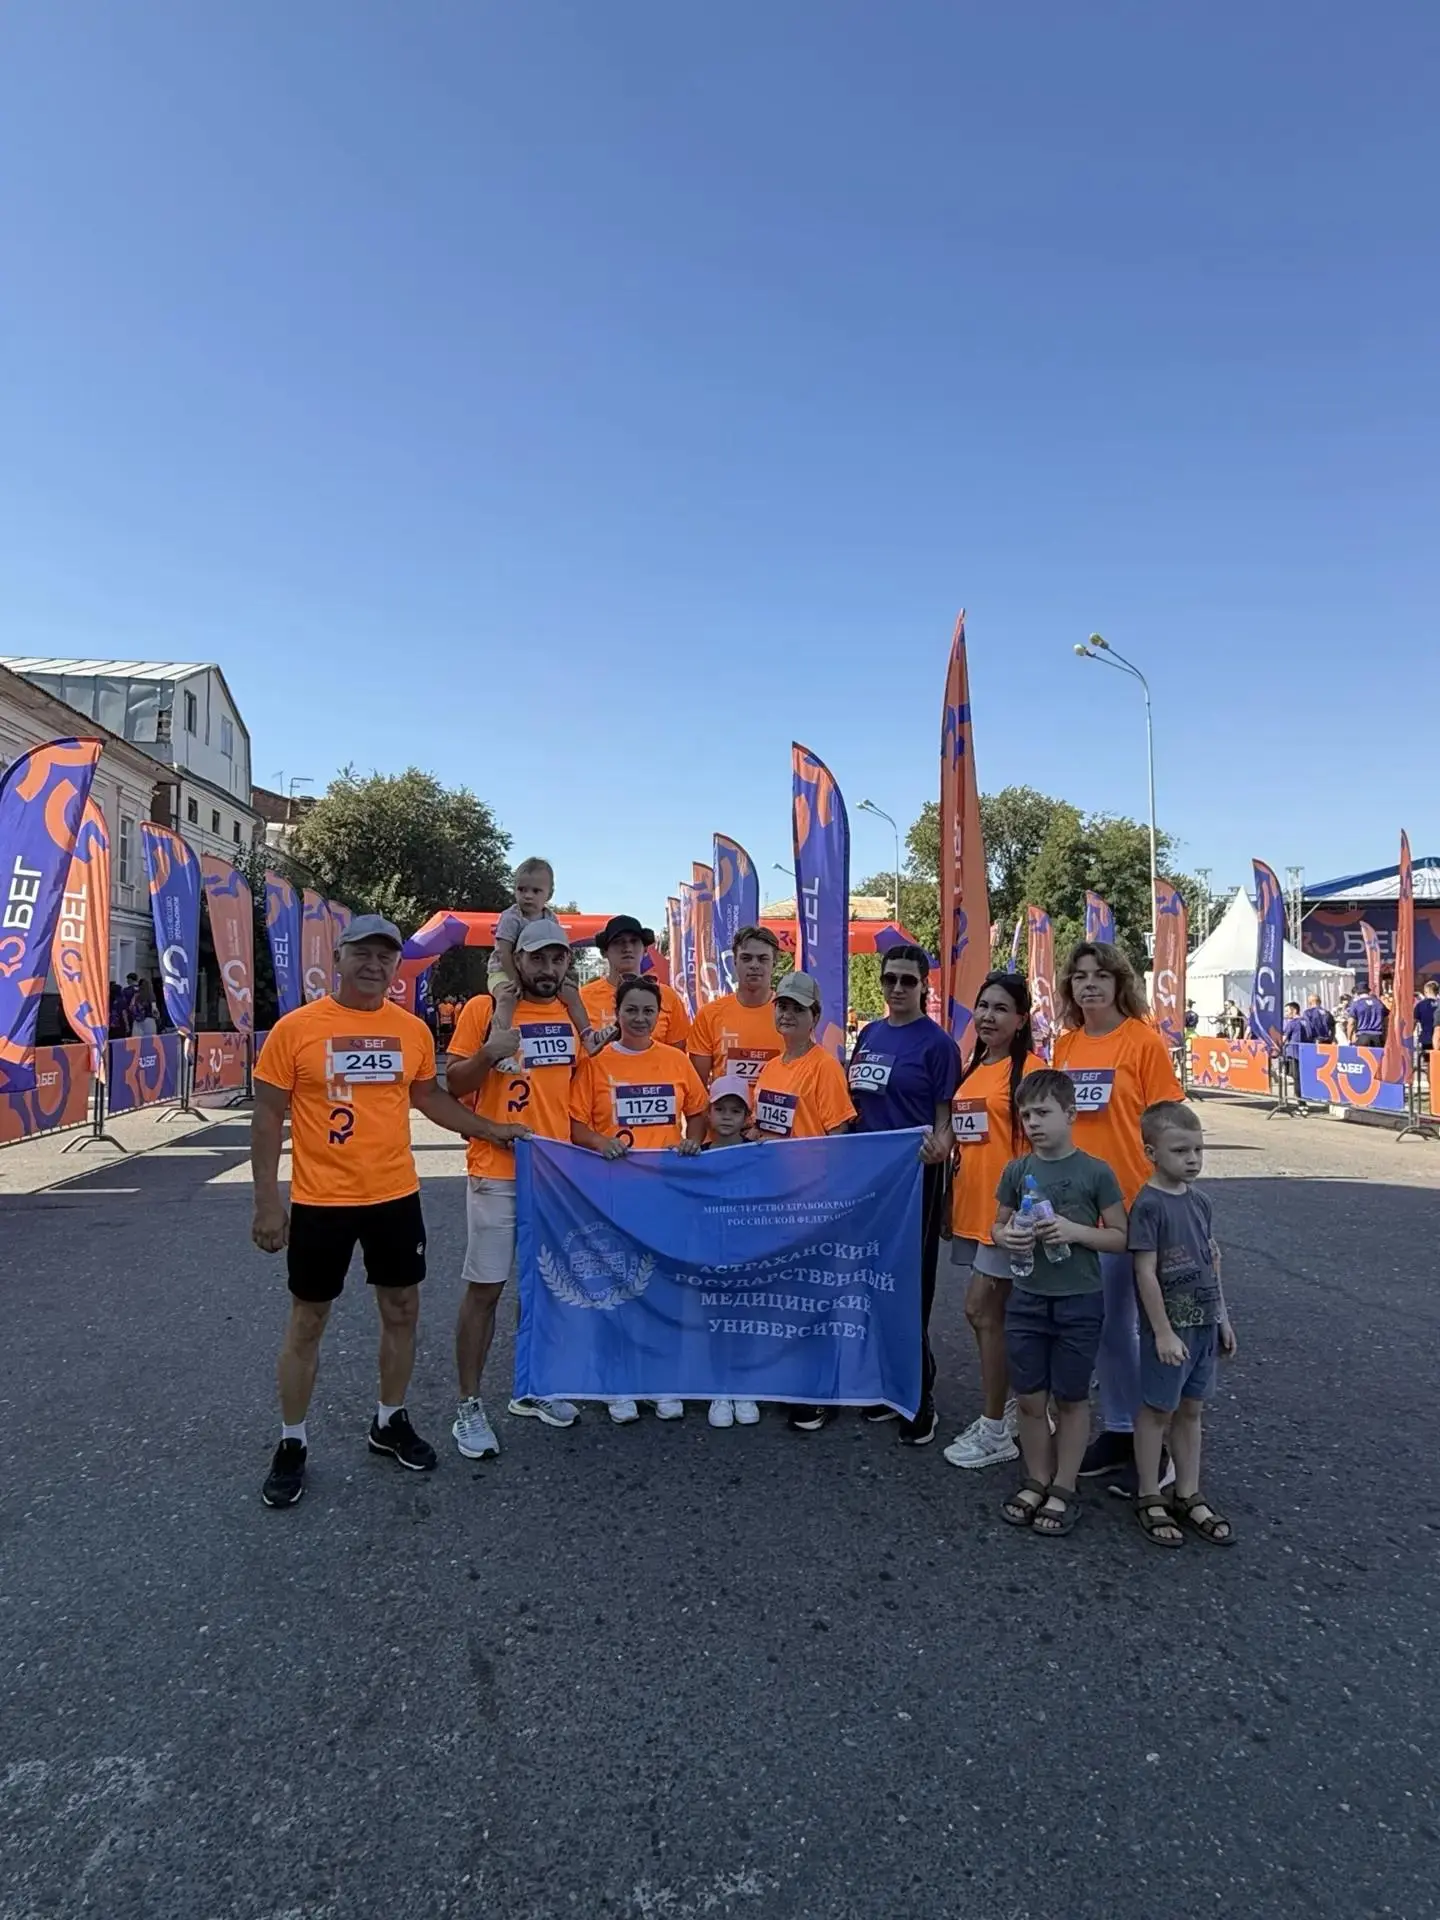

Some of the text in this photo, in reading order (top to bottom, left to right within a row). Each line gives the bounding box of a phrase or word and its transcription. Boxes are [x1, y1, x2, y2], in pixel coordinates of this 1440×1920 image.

[532, 1039, 568, 1054] 1119
[346, 1054, 393, 1070] 245
[625, 1099, 668, 1114] 1178
[762, 1105, 788, 1123] 1145
[727, 1214, 796, 1226] РОССИЙСКОЙ
[700, 1240, 880, 1274] АСТРАХАНСКИЙ
[675, 1265, 895, 1292] ГОСУДАРСТВЕННЫЙ
[708, 1319, 867, 1340] УНИВЕРСИТЕТ
